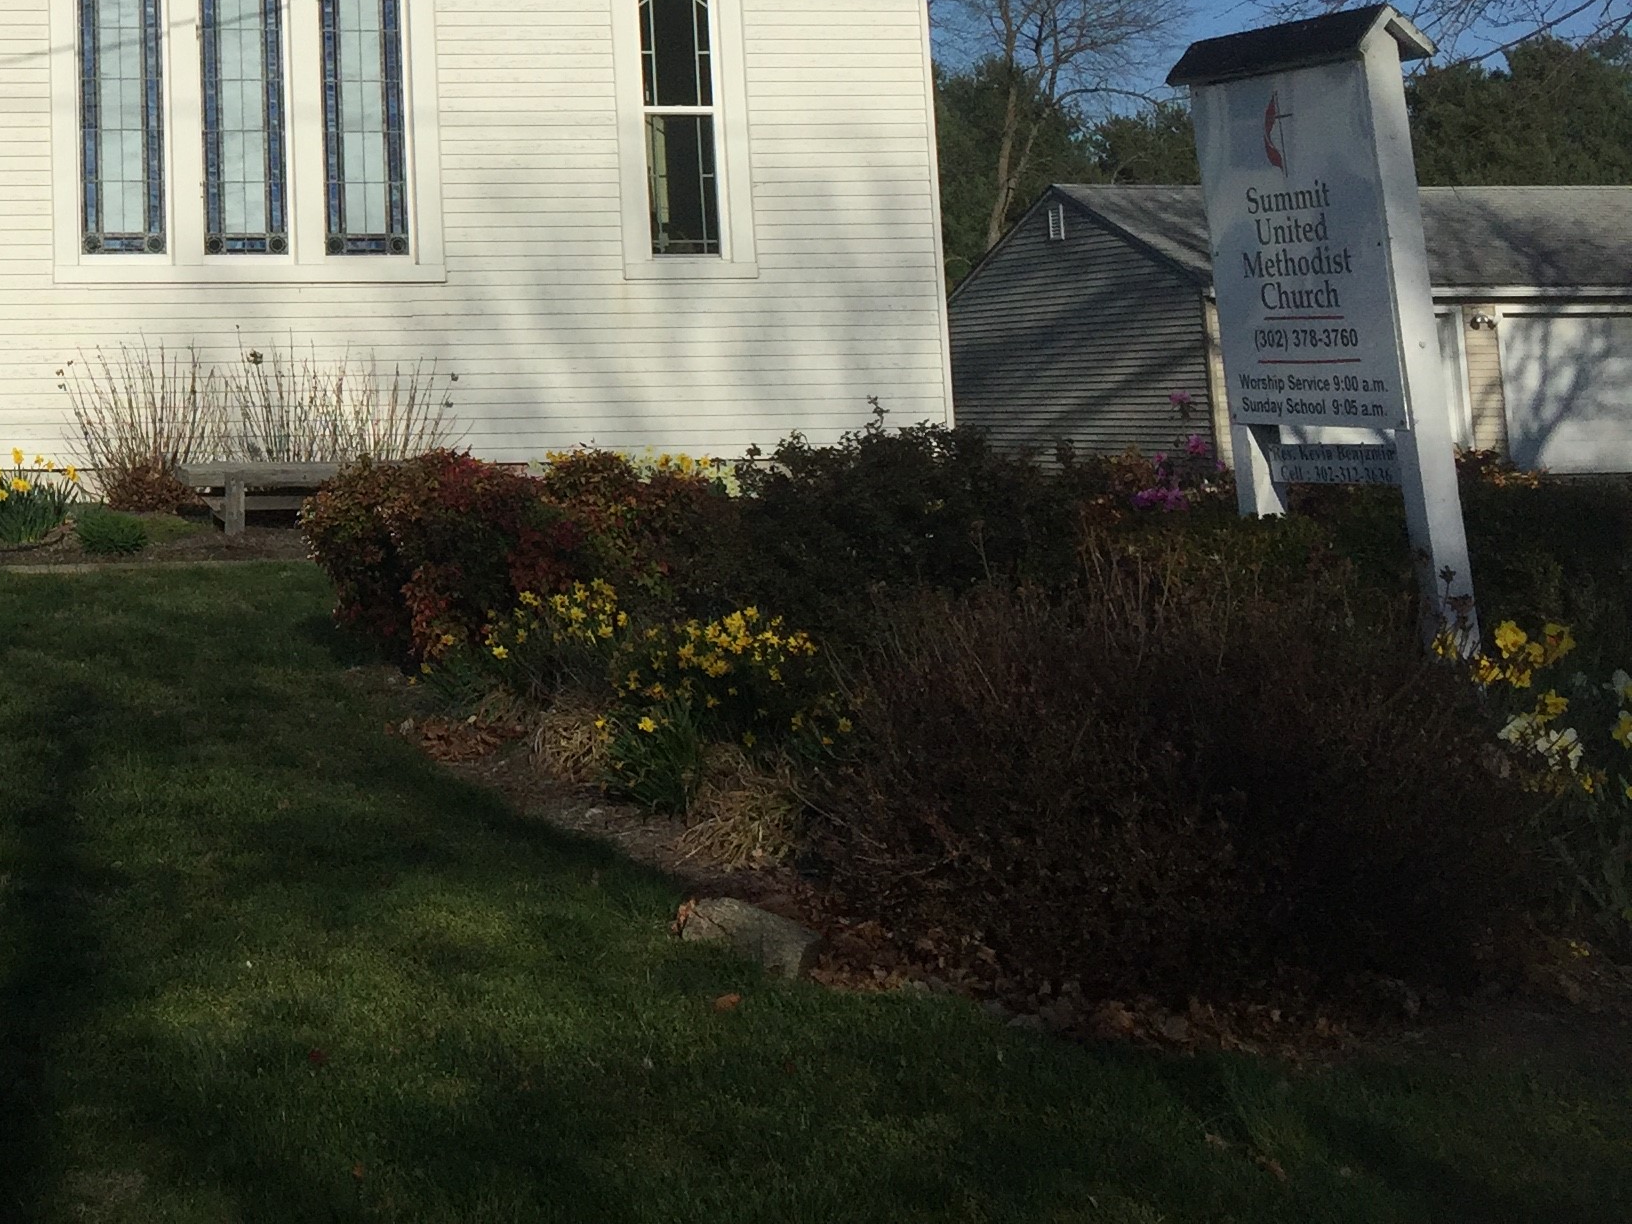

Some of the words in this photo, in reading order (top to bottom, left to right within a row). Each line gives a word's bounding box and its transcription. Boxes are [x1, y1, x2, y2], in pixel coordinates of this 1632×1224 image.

[1246, 179, 1330, 214] Summit
[1254, 213, 1329, 245] United
[1241, 246, 1352, 279] Methodist
[1261, 280, 1341, 310] Church
[1254, 328, 1288, 352] (302)
[1292, 328, 1359, 347] 378-3760
[1238, 374, 1285, 394] Worship
[1287, 374, 1331, 392] Service
[1332, 375, 1359, 392] 9:00
[1362, 378, 1389, 393] a.m.
[1242, 396, 1283, 417] Sunday
[1286, 397, 1327, 415] School
[1331, 398, 1358, 416] 9:05
[1361, 402, 1388, 417] a.m.
[1297, 445, 1333, 461] Kevin
[1337, 445, 1395, 466] Benjamin
